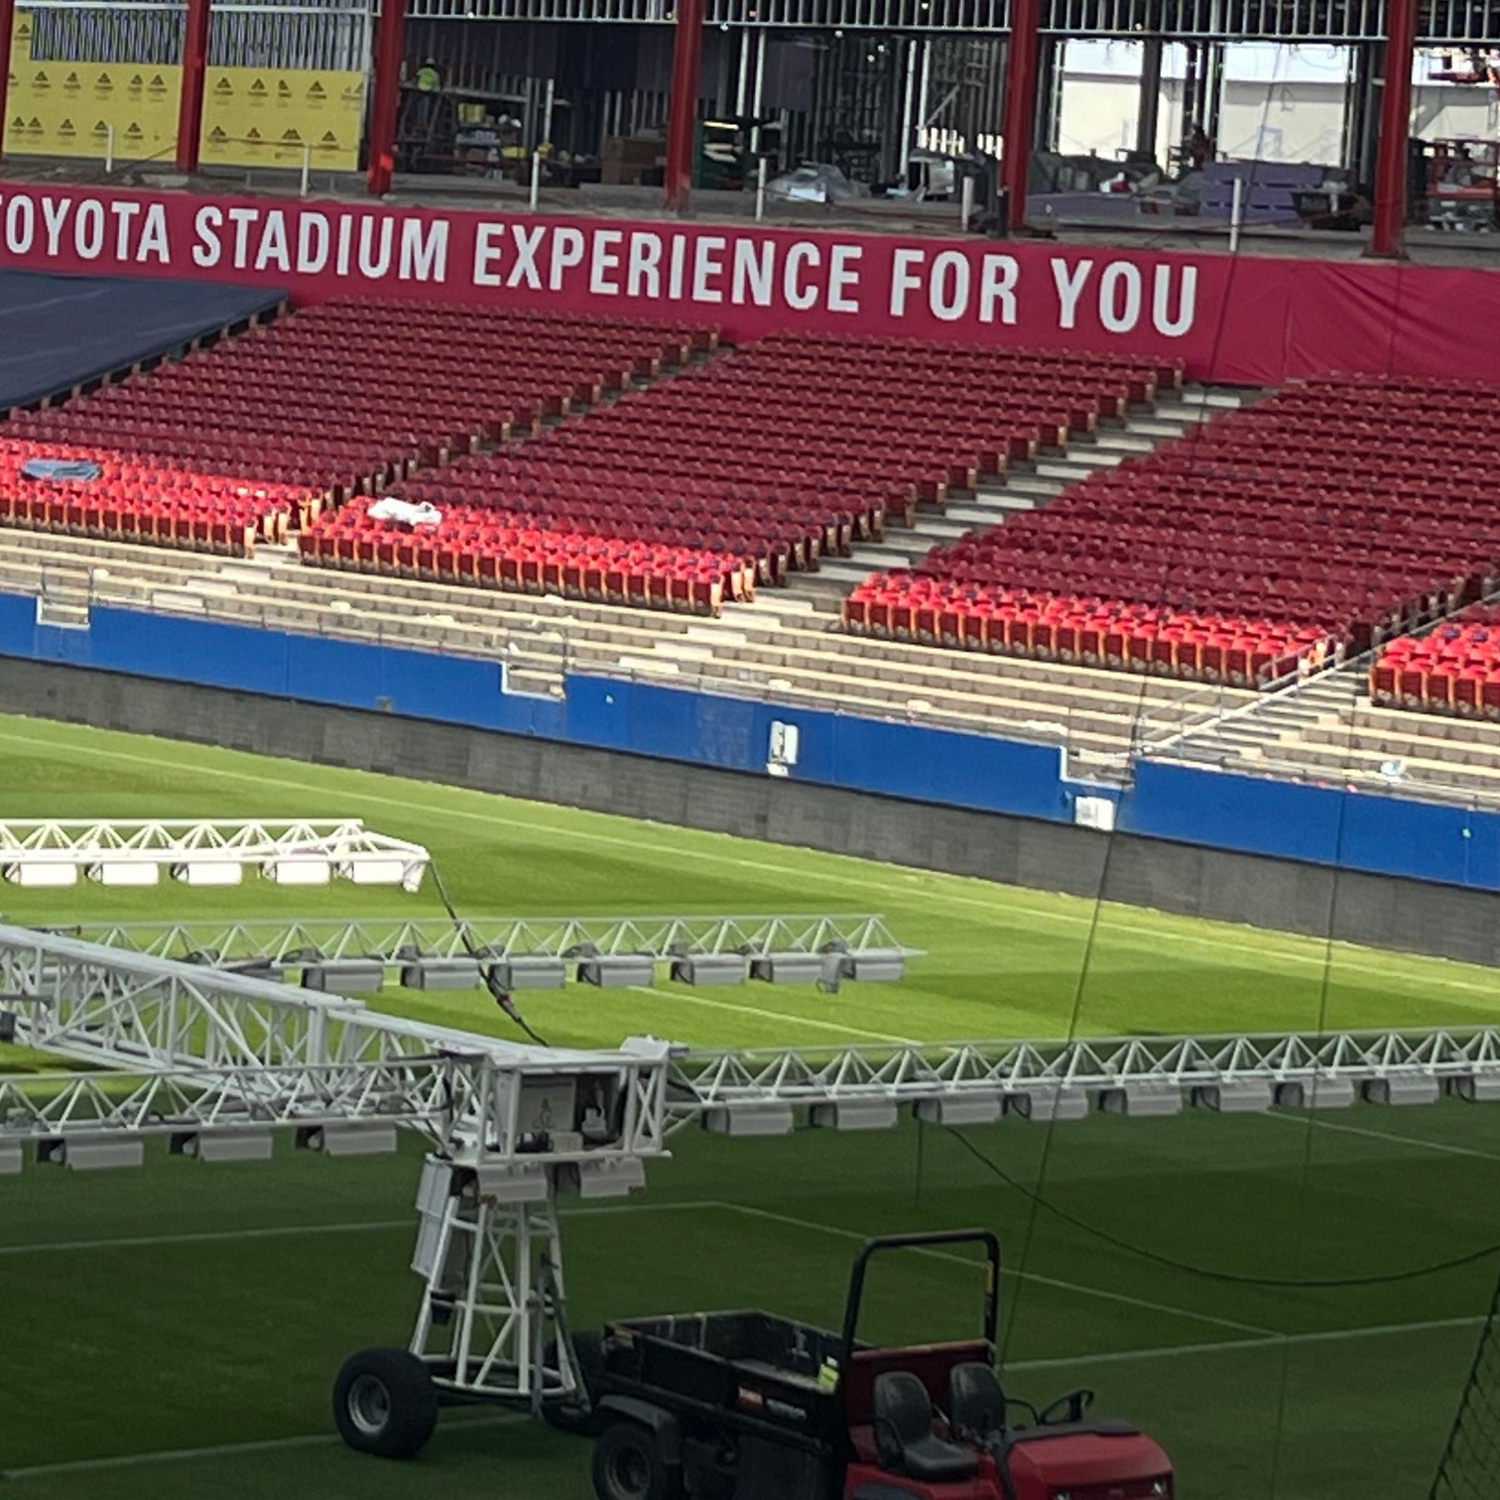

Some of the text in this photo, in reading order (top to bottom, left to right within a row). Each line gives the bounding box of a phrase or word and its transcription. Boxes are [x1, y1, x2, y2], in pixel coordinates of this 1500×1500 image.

[193, 207, 448, 281] STADIUM
[474, 223, 862, 312] EXPERIENCE
[891, 249, 1018, 323] FOR
[1052, 259, 1196, 336] YOU
